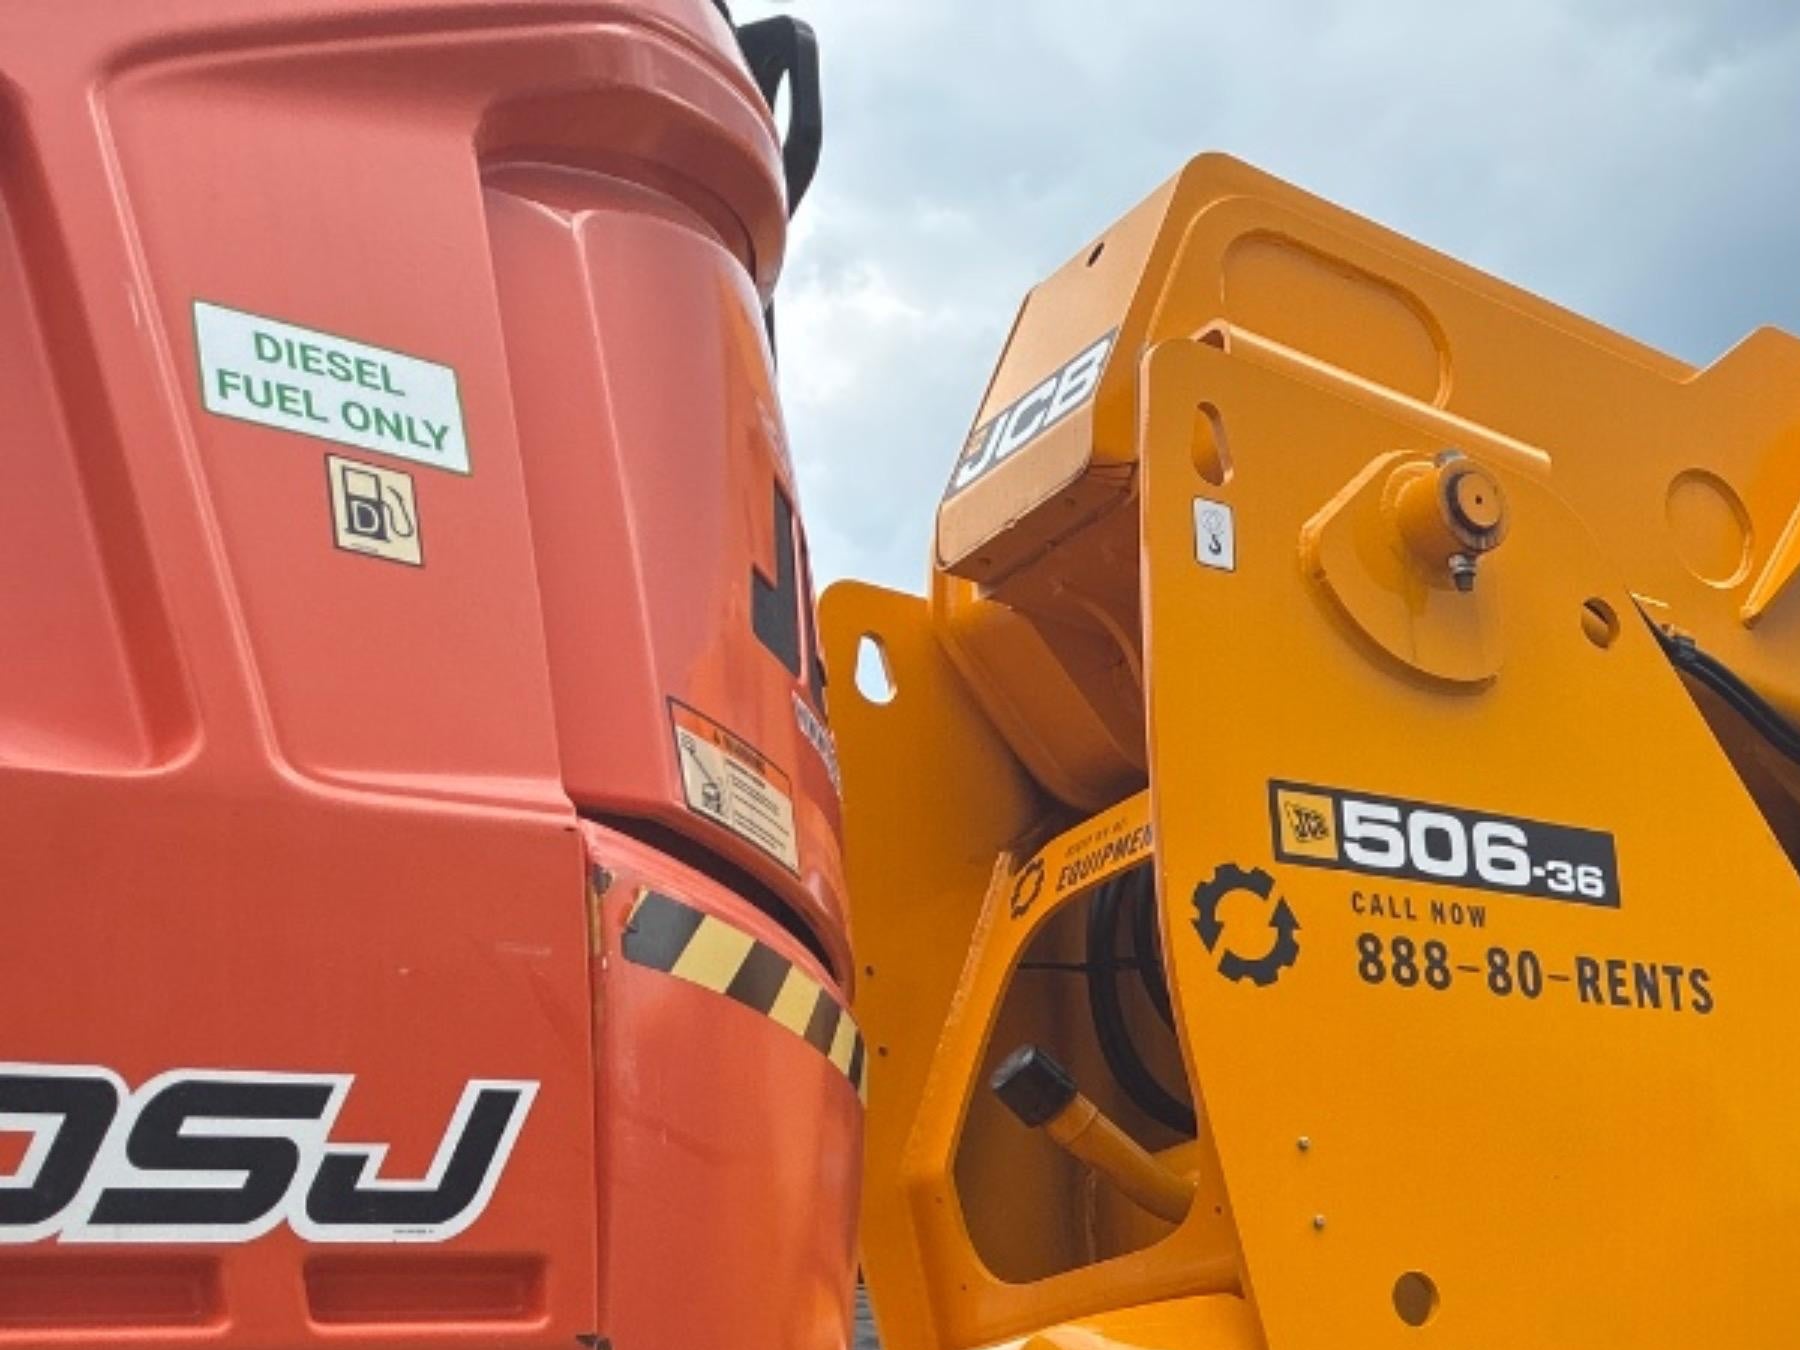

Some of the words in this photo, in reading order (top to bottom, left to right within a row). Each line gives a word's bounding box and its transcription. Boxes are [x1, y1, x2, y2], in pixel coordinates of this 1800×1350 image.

[254, 331, 406, 397] DIESEL
[216, 367, 329, 424] FUEL
[341, 400, 449, 451] ONLY
[956, 337, 1111, 488] JCB
[1341, 799, 1605, 898] 506-36
[1351, 890, 1418, 921] CALL
[1431, 901, 1487, 928] NOW
[1355, 932, 1715, 1016] 888-80-RENTS
